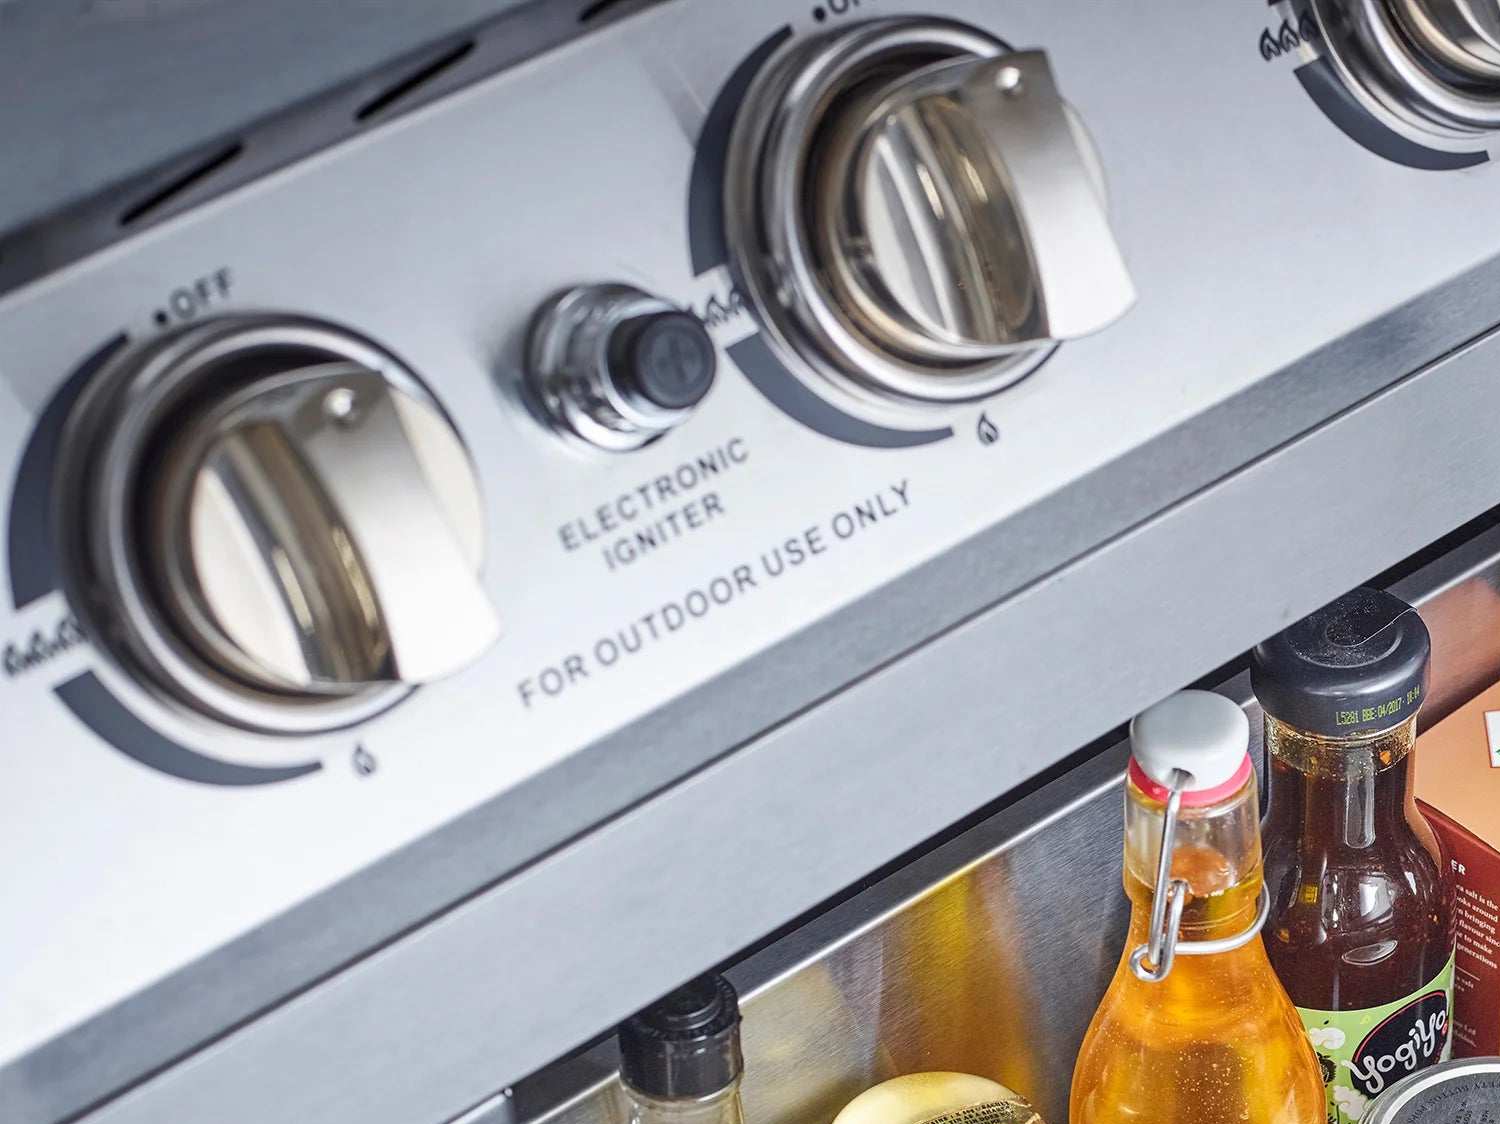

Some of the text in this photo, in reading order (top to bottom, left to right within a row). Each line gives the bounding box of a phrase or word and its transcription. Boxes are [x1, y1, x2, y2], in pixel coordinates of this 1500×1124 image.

[169, 266, 234, 319] OFF
[557, 437, 750, 552] ELECTRONIC
[604, 492, 725, 571] IGNITER
[517, 480, 912, 707] FOR OUTDOOR USE ONLY
